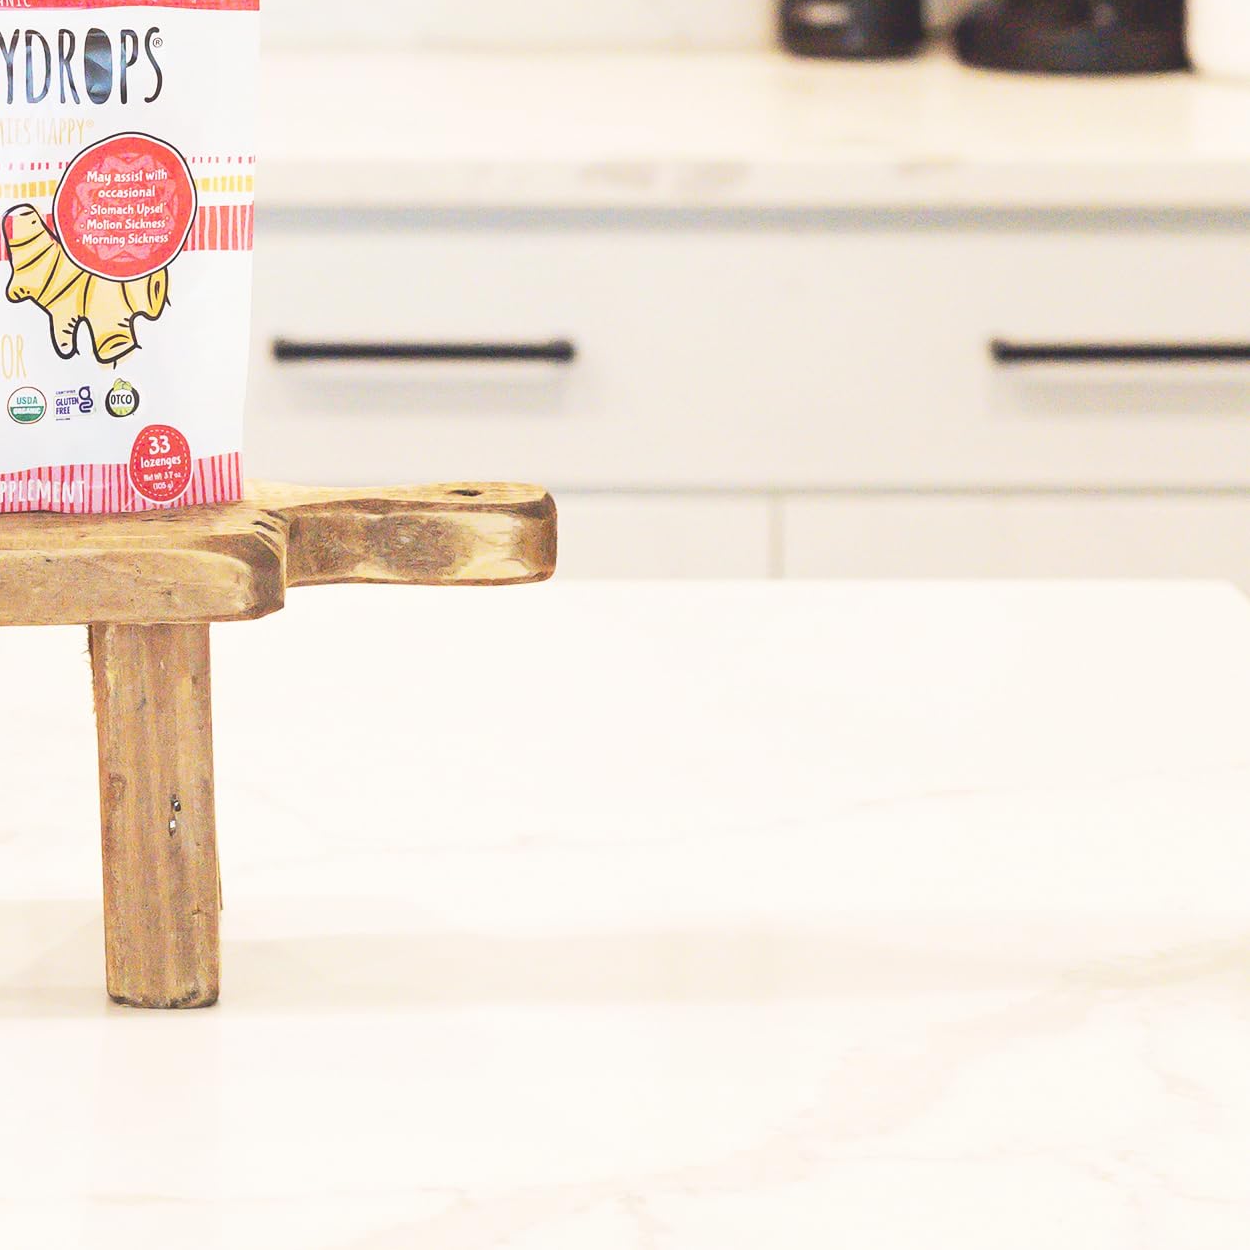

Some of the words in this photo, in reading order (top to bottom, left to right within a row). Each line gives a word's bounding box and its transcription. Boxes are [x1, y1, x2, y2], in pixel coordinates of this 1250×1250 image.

[86, 170, 111, 186] May
[114, 169, 143, 182] assist
[145, 168, 168, 181] with
[98, 185, 156, 198] occasional
[90, 204, 134, 215] Stomach
[86, 219, 122, 230] Motion
[82, 234, 126, 247] Morning
[16, 396, 38, 405] USDA
[55, 396, 79, 407] GLUTEN
[110, 394, 132, 405] OTCO
[55, 406, 70, 415] FREE
[148, 434, 171, 455] 33
[140, 456, 181, 470] lozenges
